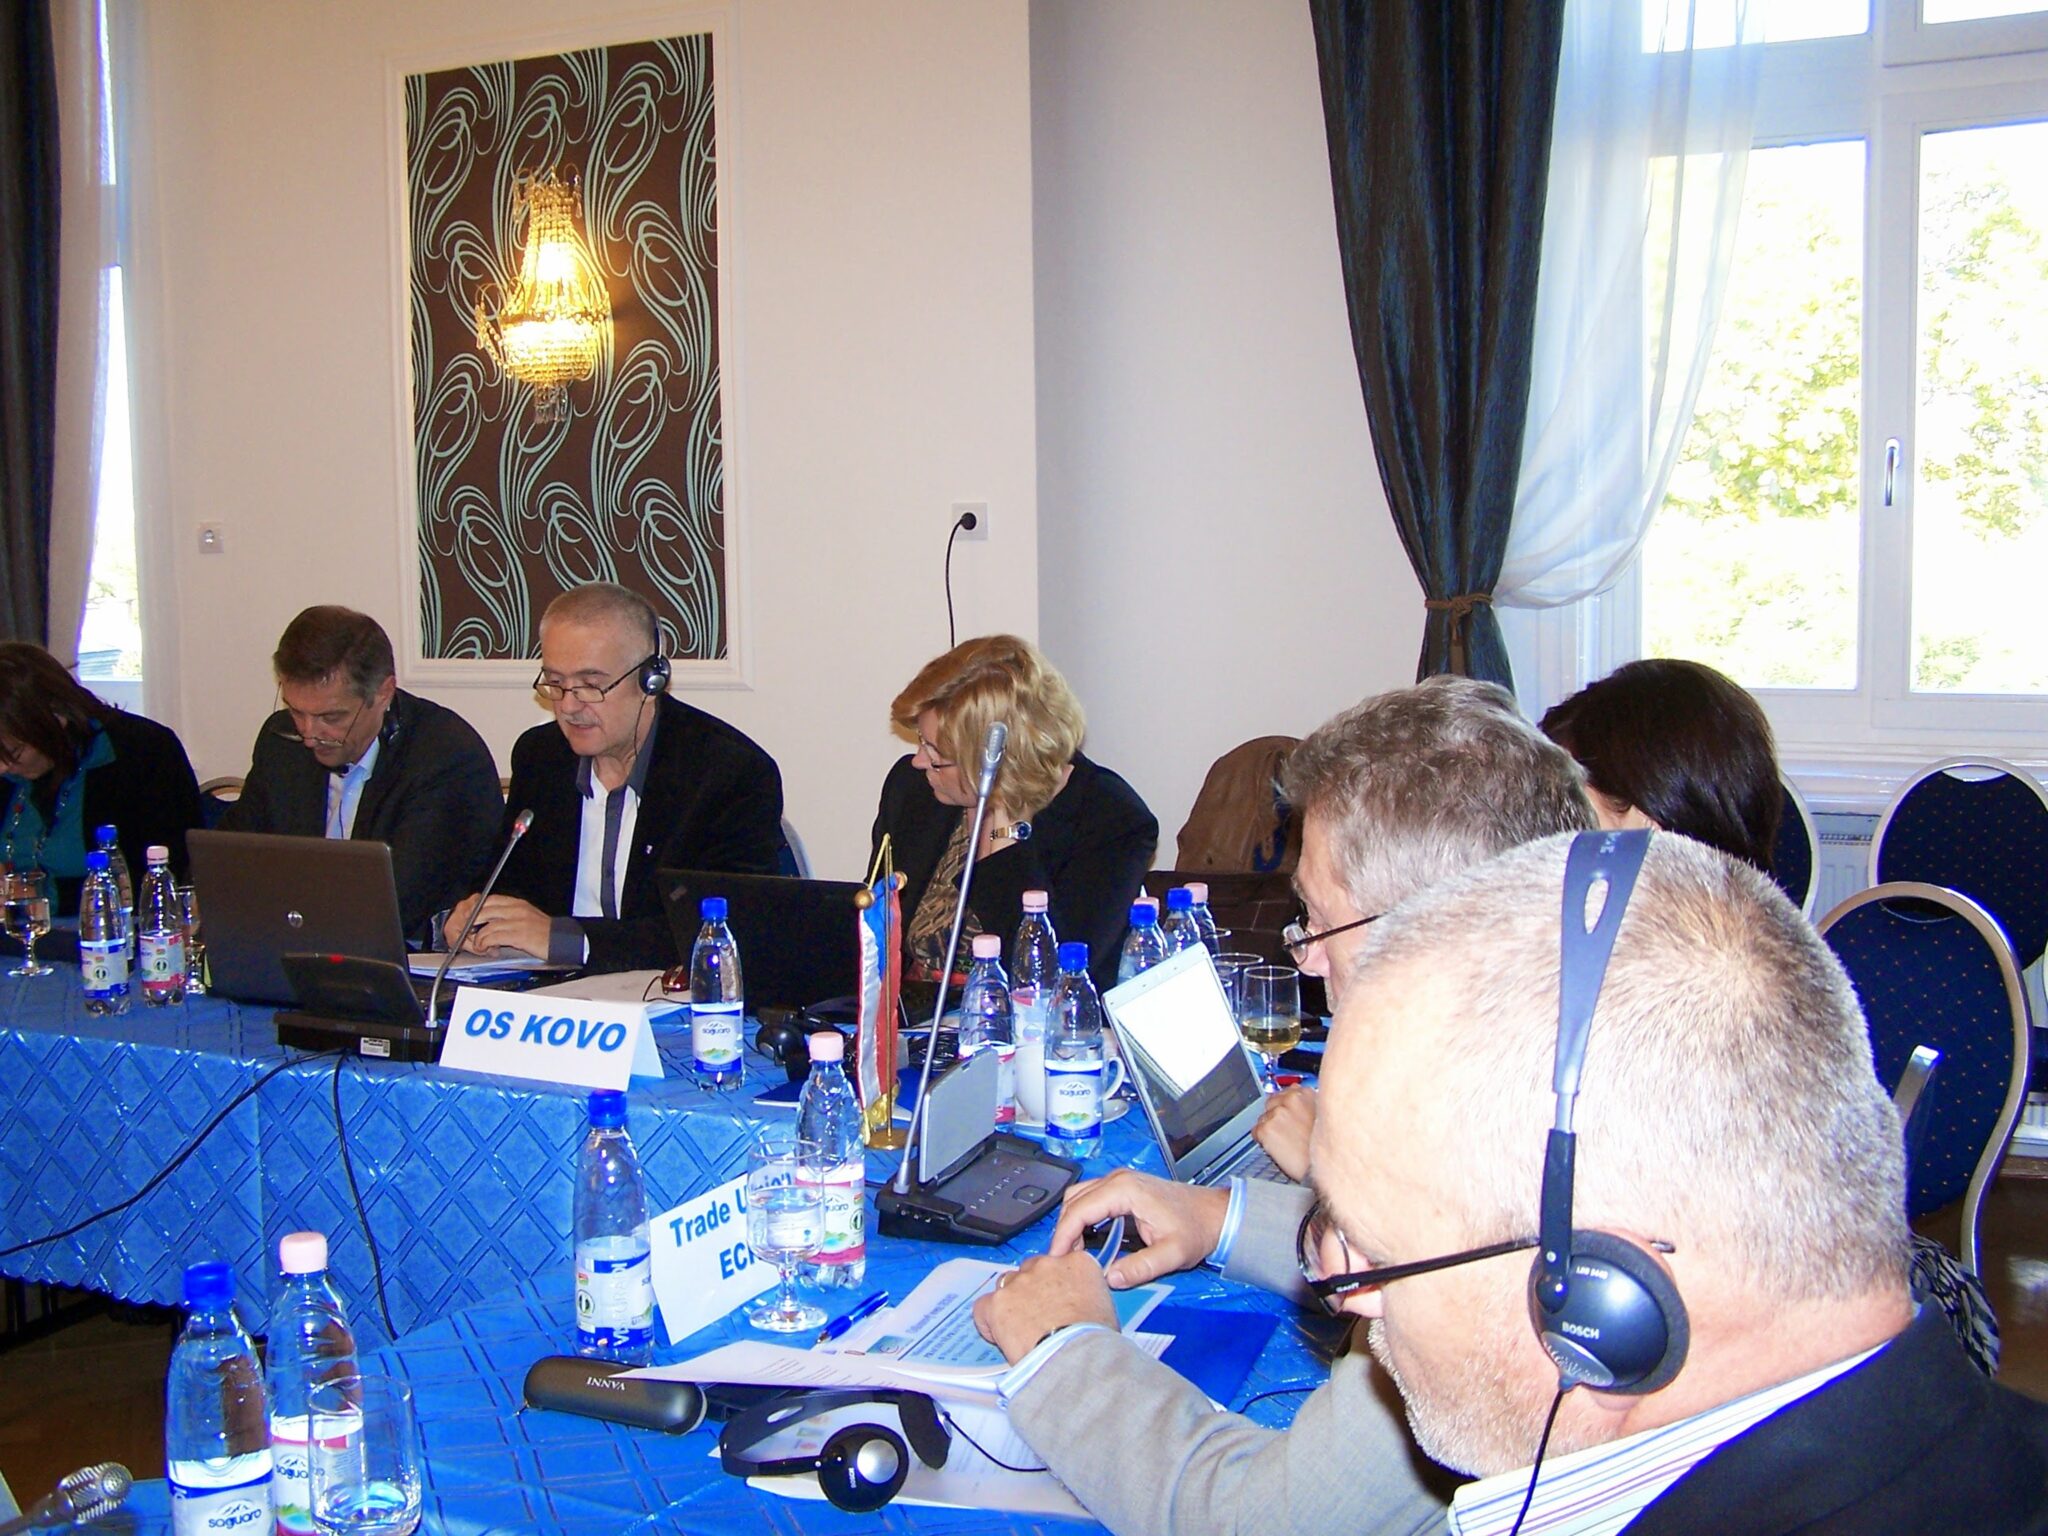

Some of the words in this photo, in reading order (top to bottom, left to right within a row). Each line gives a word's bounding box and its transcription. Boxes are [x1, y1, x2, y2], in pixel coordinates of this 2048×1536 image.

[464, 1008, 515, 1040] OS
[519, 1014, 627, 1052] KOVO
[669, 1200, 731, 1248] Trade
[1562, 1321, 1600, 1340] BOSCH
[586, 1376, 626, 1391] VANNI
[208, 1508, 262, 1530] saguaro
